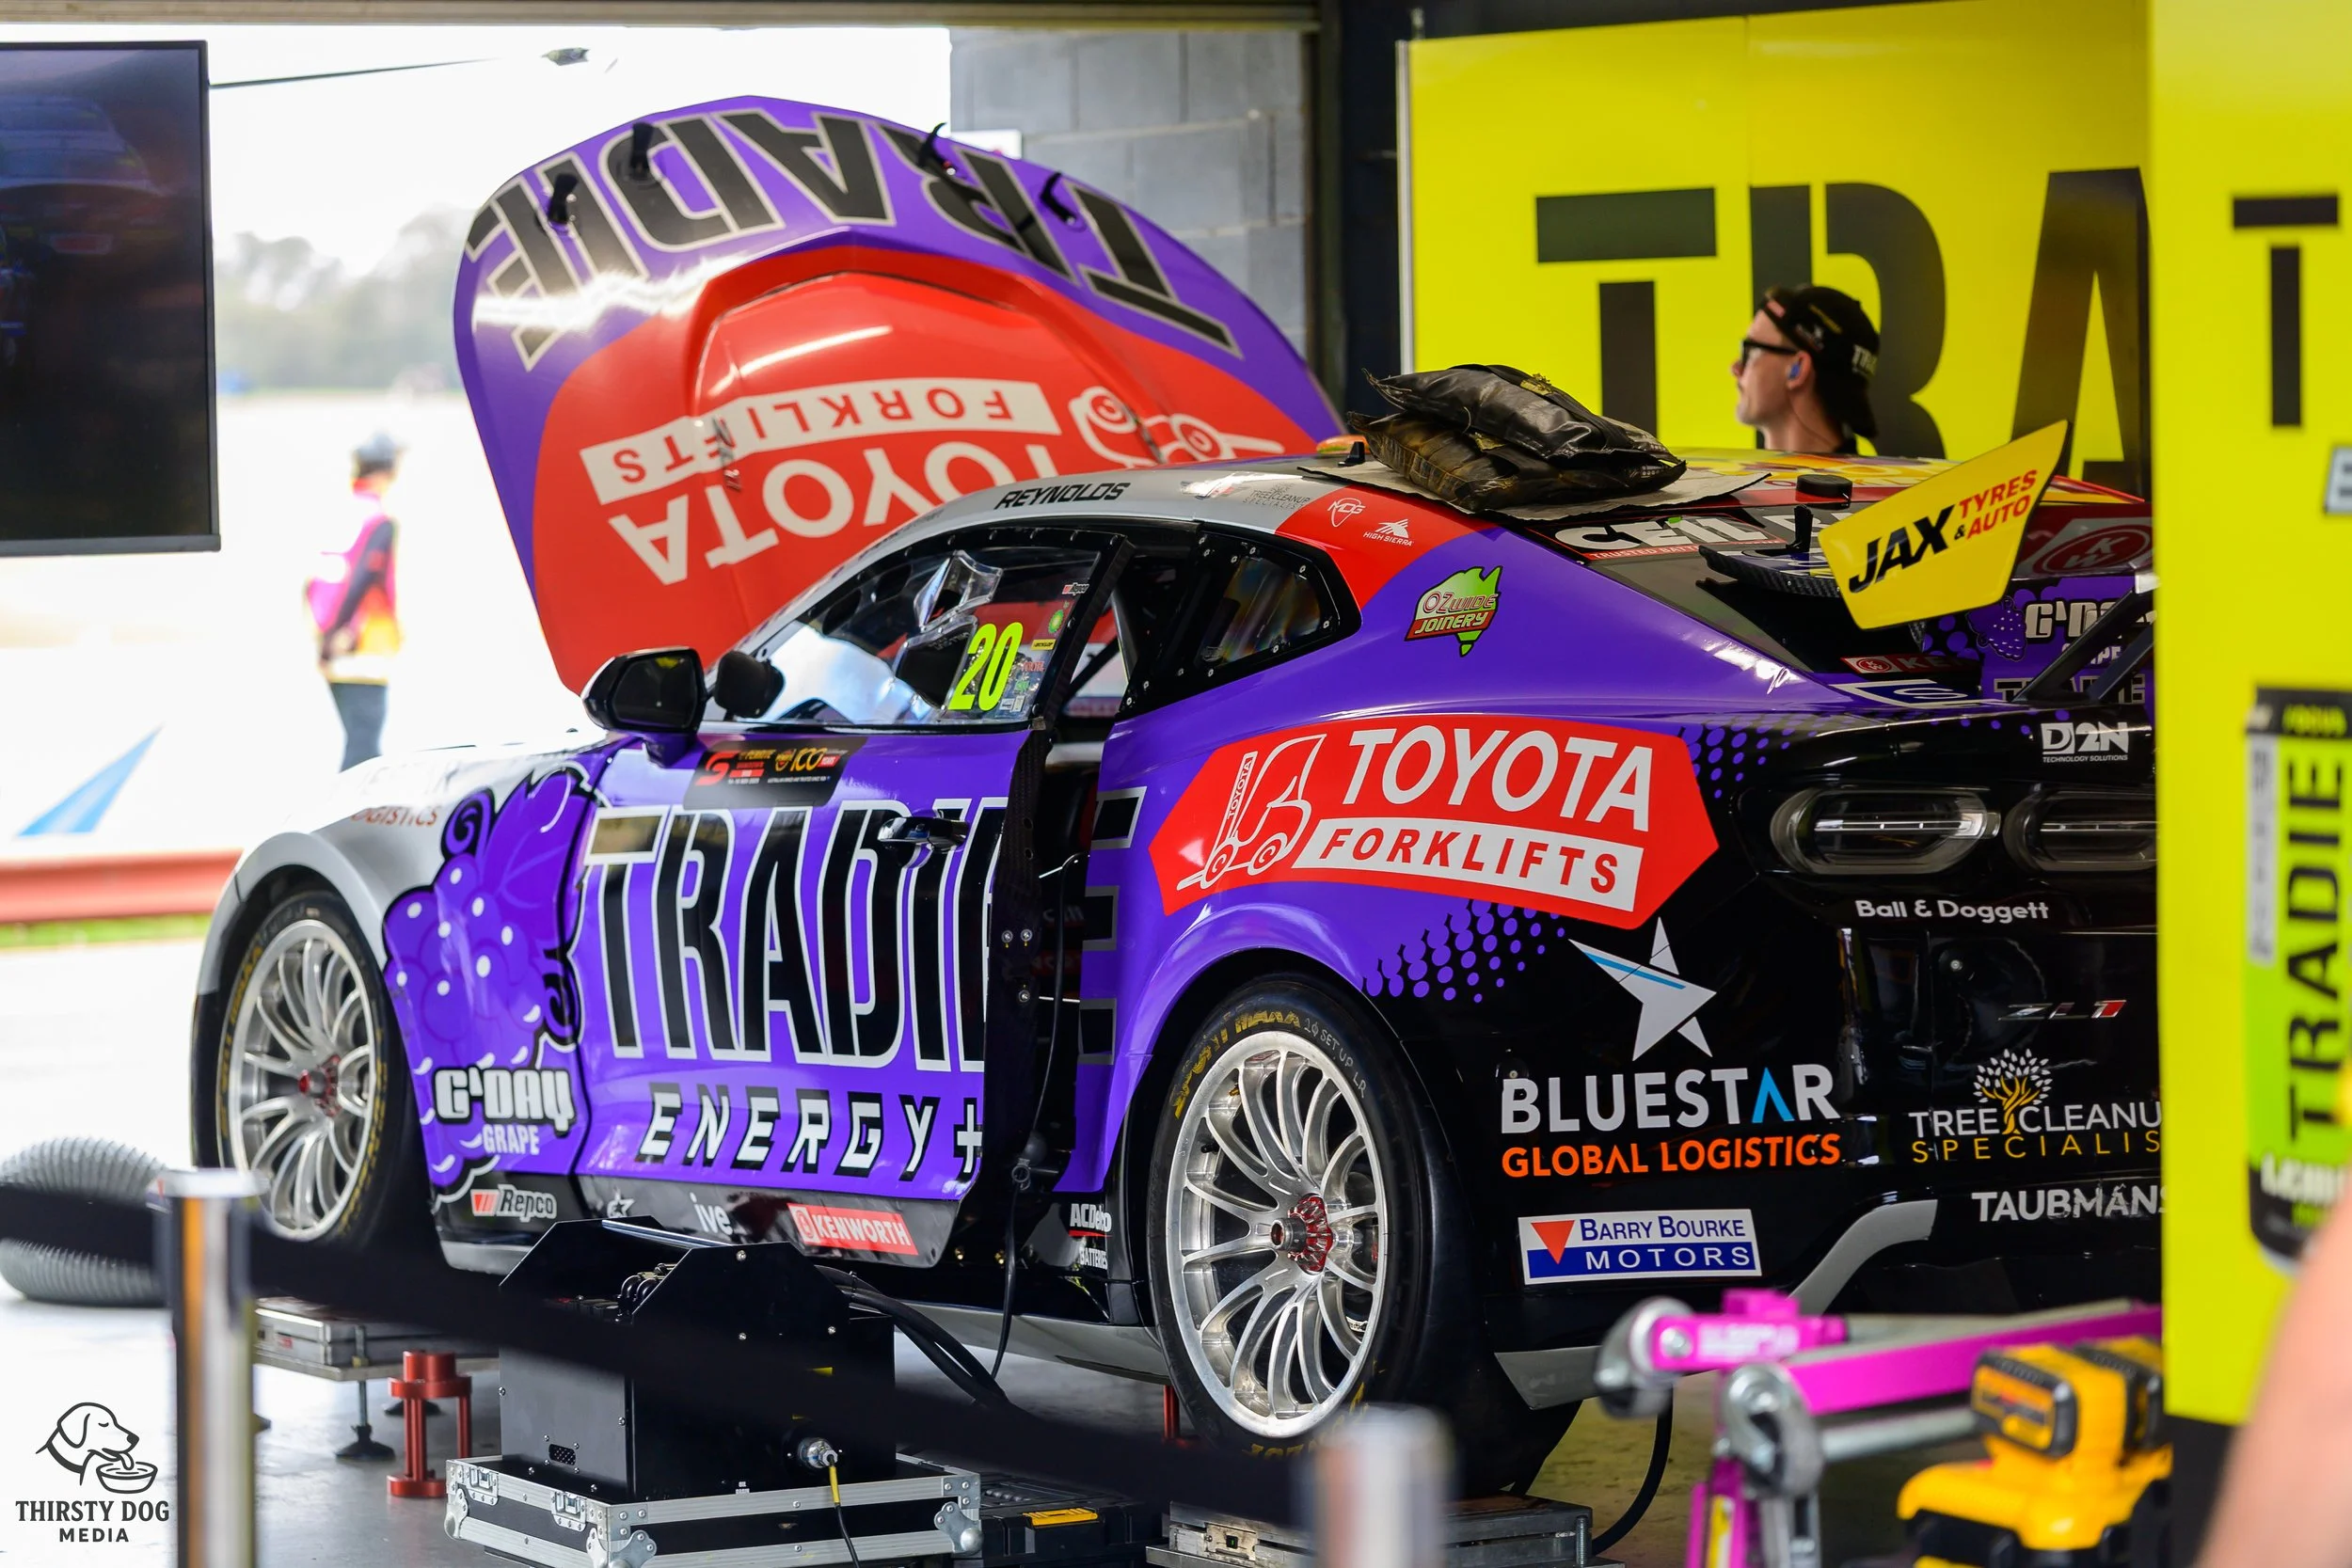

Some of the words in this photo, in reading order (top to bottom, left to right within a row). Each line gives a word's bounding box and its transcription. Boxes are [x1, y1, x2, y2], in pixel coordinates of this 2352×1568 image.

[465, 106, 1245, 372] TRADIE
[2231, 194, 2341, 429] T
[612, 388, 1016, 484] FORKLIFTS
[993, 482, 1132, 510] REYNOLDS
[1958, 468, 2039, 519] TYRES
[1362, 531, 1384, 542] HIGH
[1384, 535, 1413, 547] SIERRA
[1953, 524, 1966, 542] &
[1965, 493, 2032, 542] AUTO
[1592, 547, 1660, 561] TRUSTED
[1848, 504, 1955, 594] JAX
[946, 621, 1025, 712] 20
[2040, 721, 2129, 755] D2N
[2042, 755, 2089, 764] TECHNOLOGY
[2089, 753, 2129, 763] SOLUTIONS
[1227, 758, 1252, 821] TOYOTA
[1340, 724, 1655, 833] TOYOTA
[346, 805, 438, 828] OGISTICS
[1317, 826, 1619, 895] FORKLIFTS
[1854, 899, 1908, 918] Ball
[1914, 899, 1932, 918] &
[1936, 899, 2050, 924] Doggett
[2287, 758, 2343, 1142] TRADIE
[1319, 1028, 1341, 1052] SET
[1339, 1047, 1354, 1068] UP
[1352, 1070, 1368, 1099] LR
[435, 1066, 577, 1132] G'DAY
[1500, 1063, 1842, 1134] BLUESTAR
[481, 1123, 540, 1156] GRAPE
[1908, 1107, 2000, 1138] TREE
[1502, 1142, 1649, 1179] GLOBAL
[1660, 1132, 1842, 1172] LOGISTICS
[1911, 1130, 2162, 1163] SPECIALIS
[499, 1188, 557, 1220] Repco
[690, 1191, 735, 1236] ive
[814, 1212, 913, 1248] KENWORTH
[1579, 1217, 1653, 1242] BARRY
[1657, 1214, 1746, 1239] BOURKE
[1585, 1245, 1752, 1272] MOTORS
